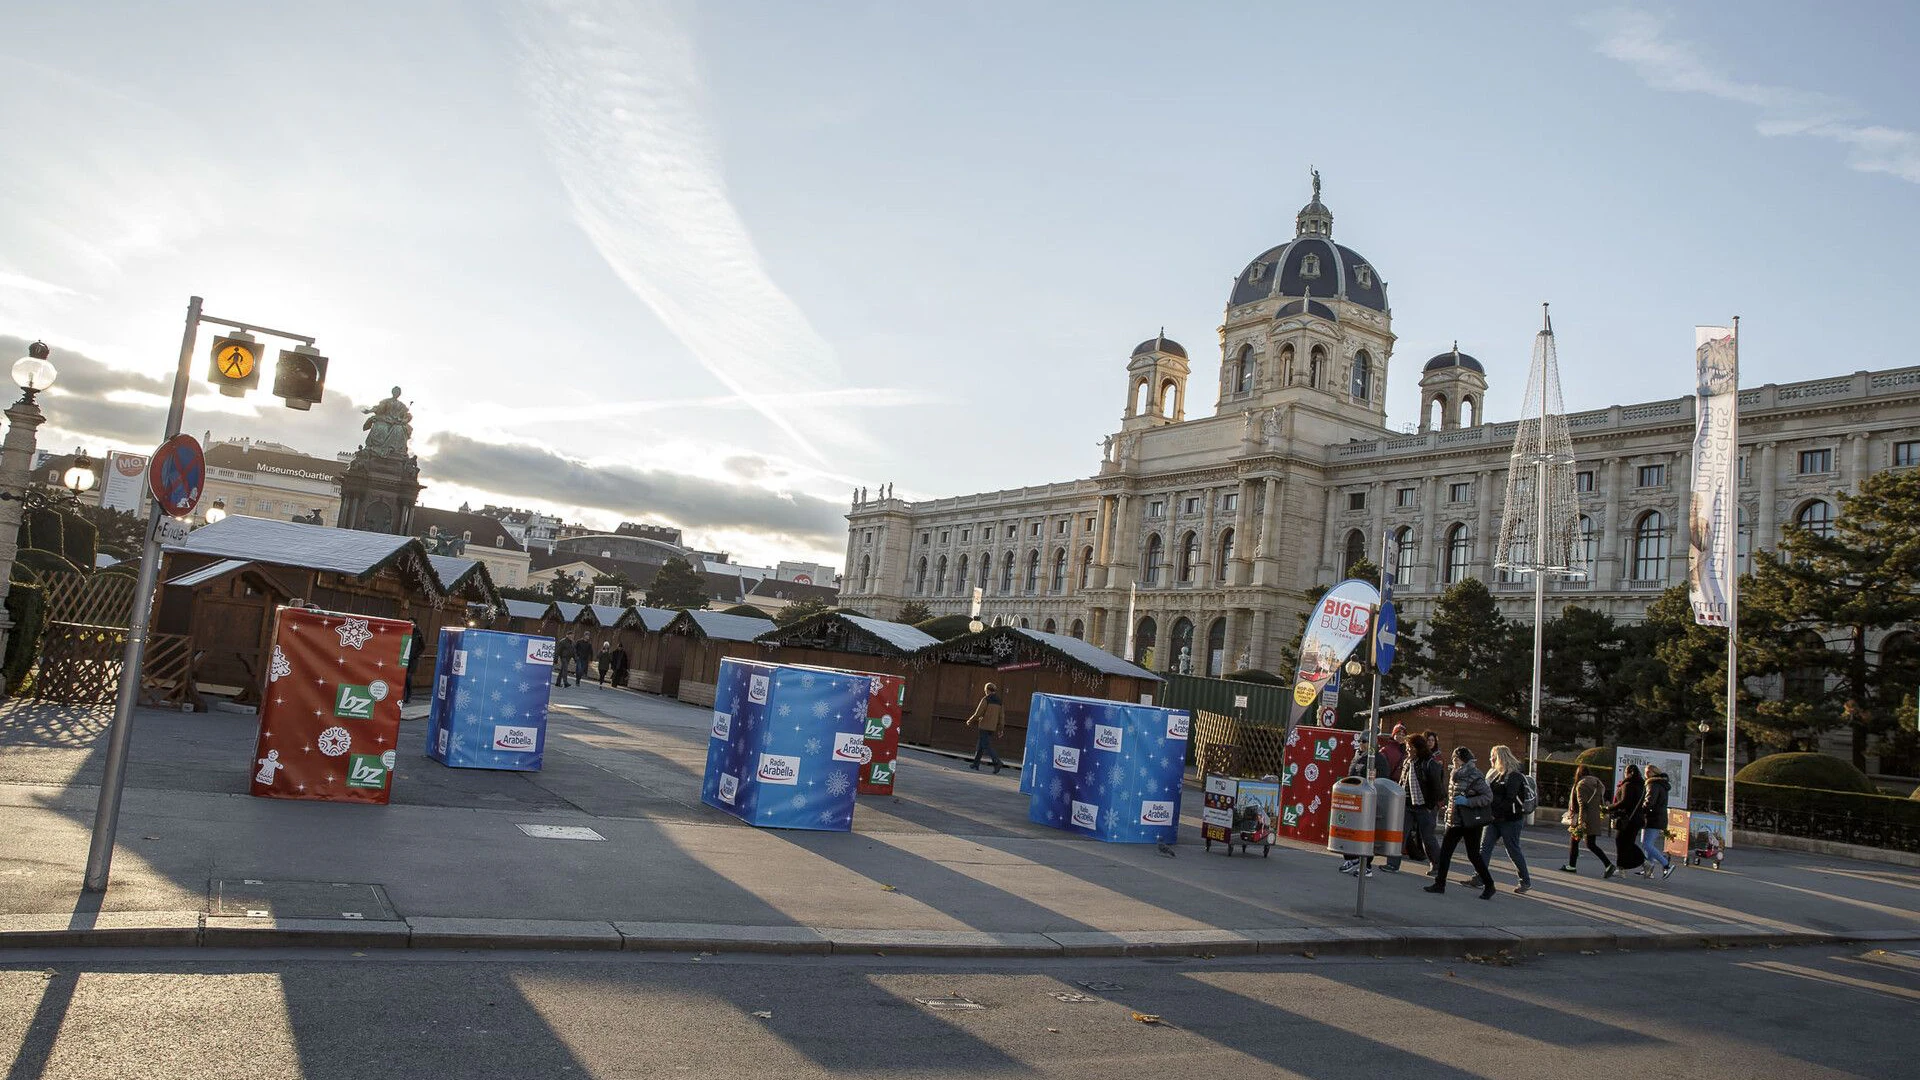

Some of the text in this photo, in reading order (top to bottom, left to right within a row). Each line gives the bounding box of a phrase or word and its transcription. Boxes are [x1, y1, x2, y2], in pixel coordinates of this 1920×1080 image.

[256, 462, 334, 482] MuseumsQuartier
[1323, 599, 1352, 619] BIG
[1320, 613, 1349, 632] BUS
[339, 687, 371, 714] bz
[1439, 707, 1469, 719] Fotobox
[509, 729, 524, 737] Radio
[865, 719, 884, 737] bz
[1316, 741, 1331, 759] bz
[351, 756, 383, 784] bz
[769, 758, 786, 768] Radio
[872, 764, 891, 782] bz
[1283, 806, 1297, 824] bz
